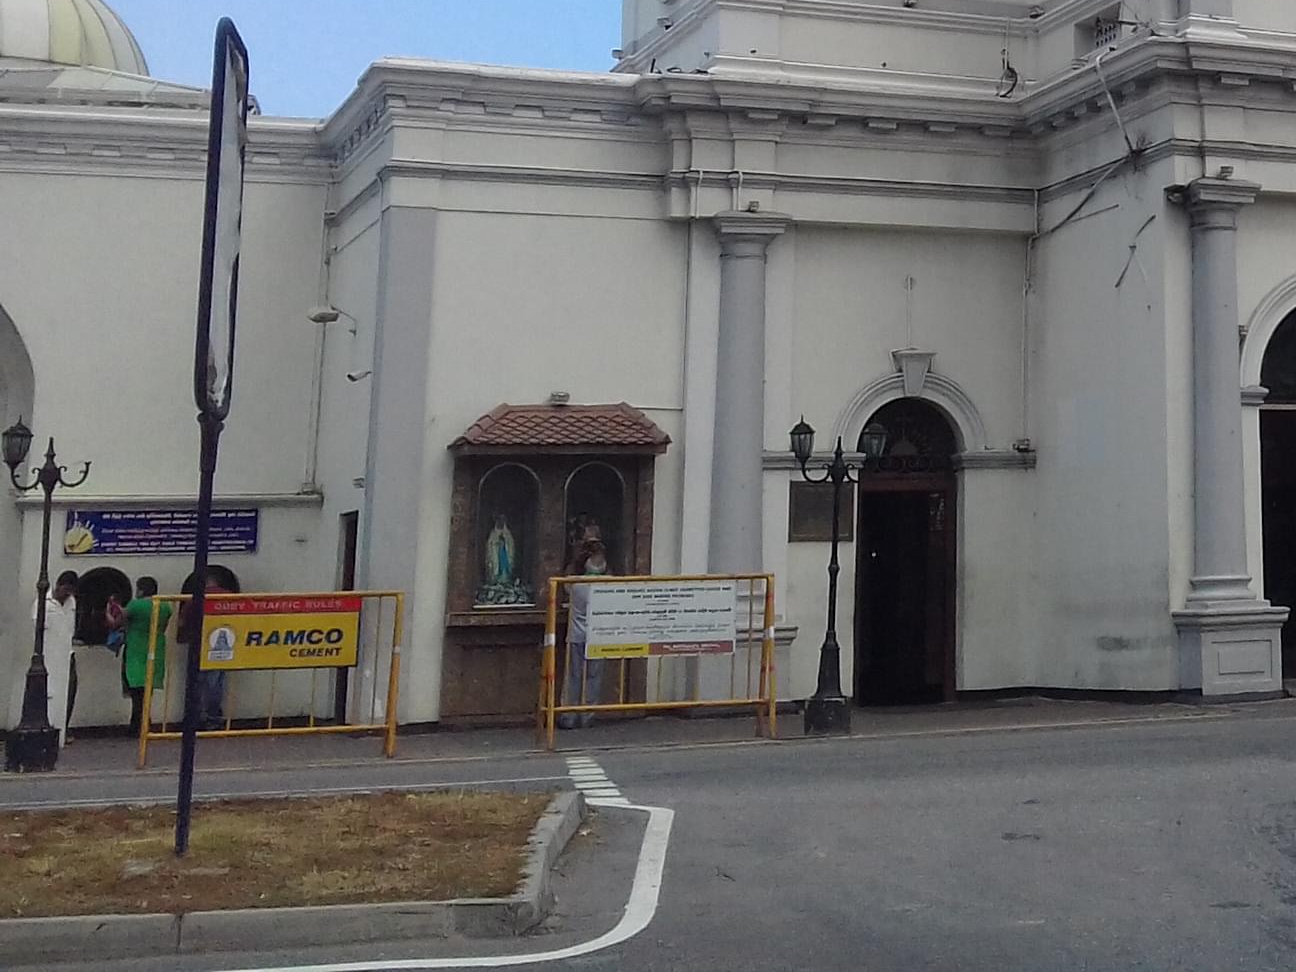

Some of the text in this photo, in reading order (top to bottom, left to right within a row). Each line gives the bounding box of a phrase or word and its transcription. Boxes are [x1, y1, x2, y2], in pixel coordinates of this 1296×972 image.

[253, 601, 300, 610] TRAFFIC
[305, 599, 343, 608] RULES
[245, 628, 344, 646] RAMCO
[289, 647, 343, 658] CEMENT
